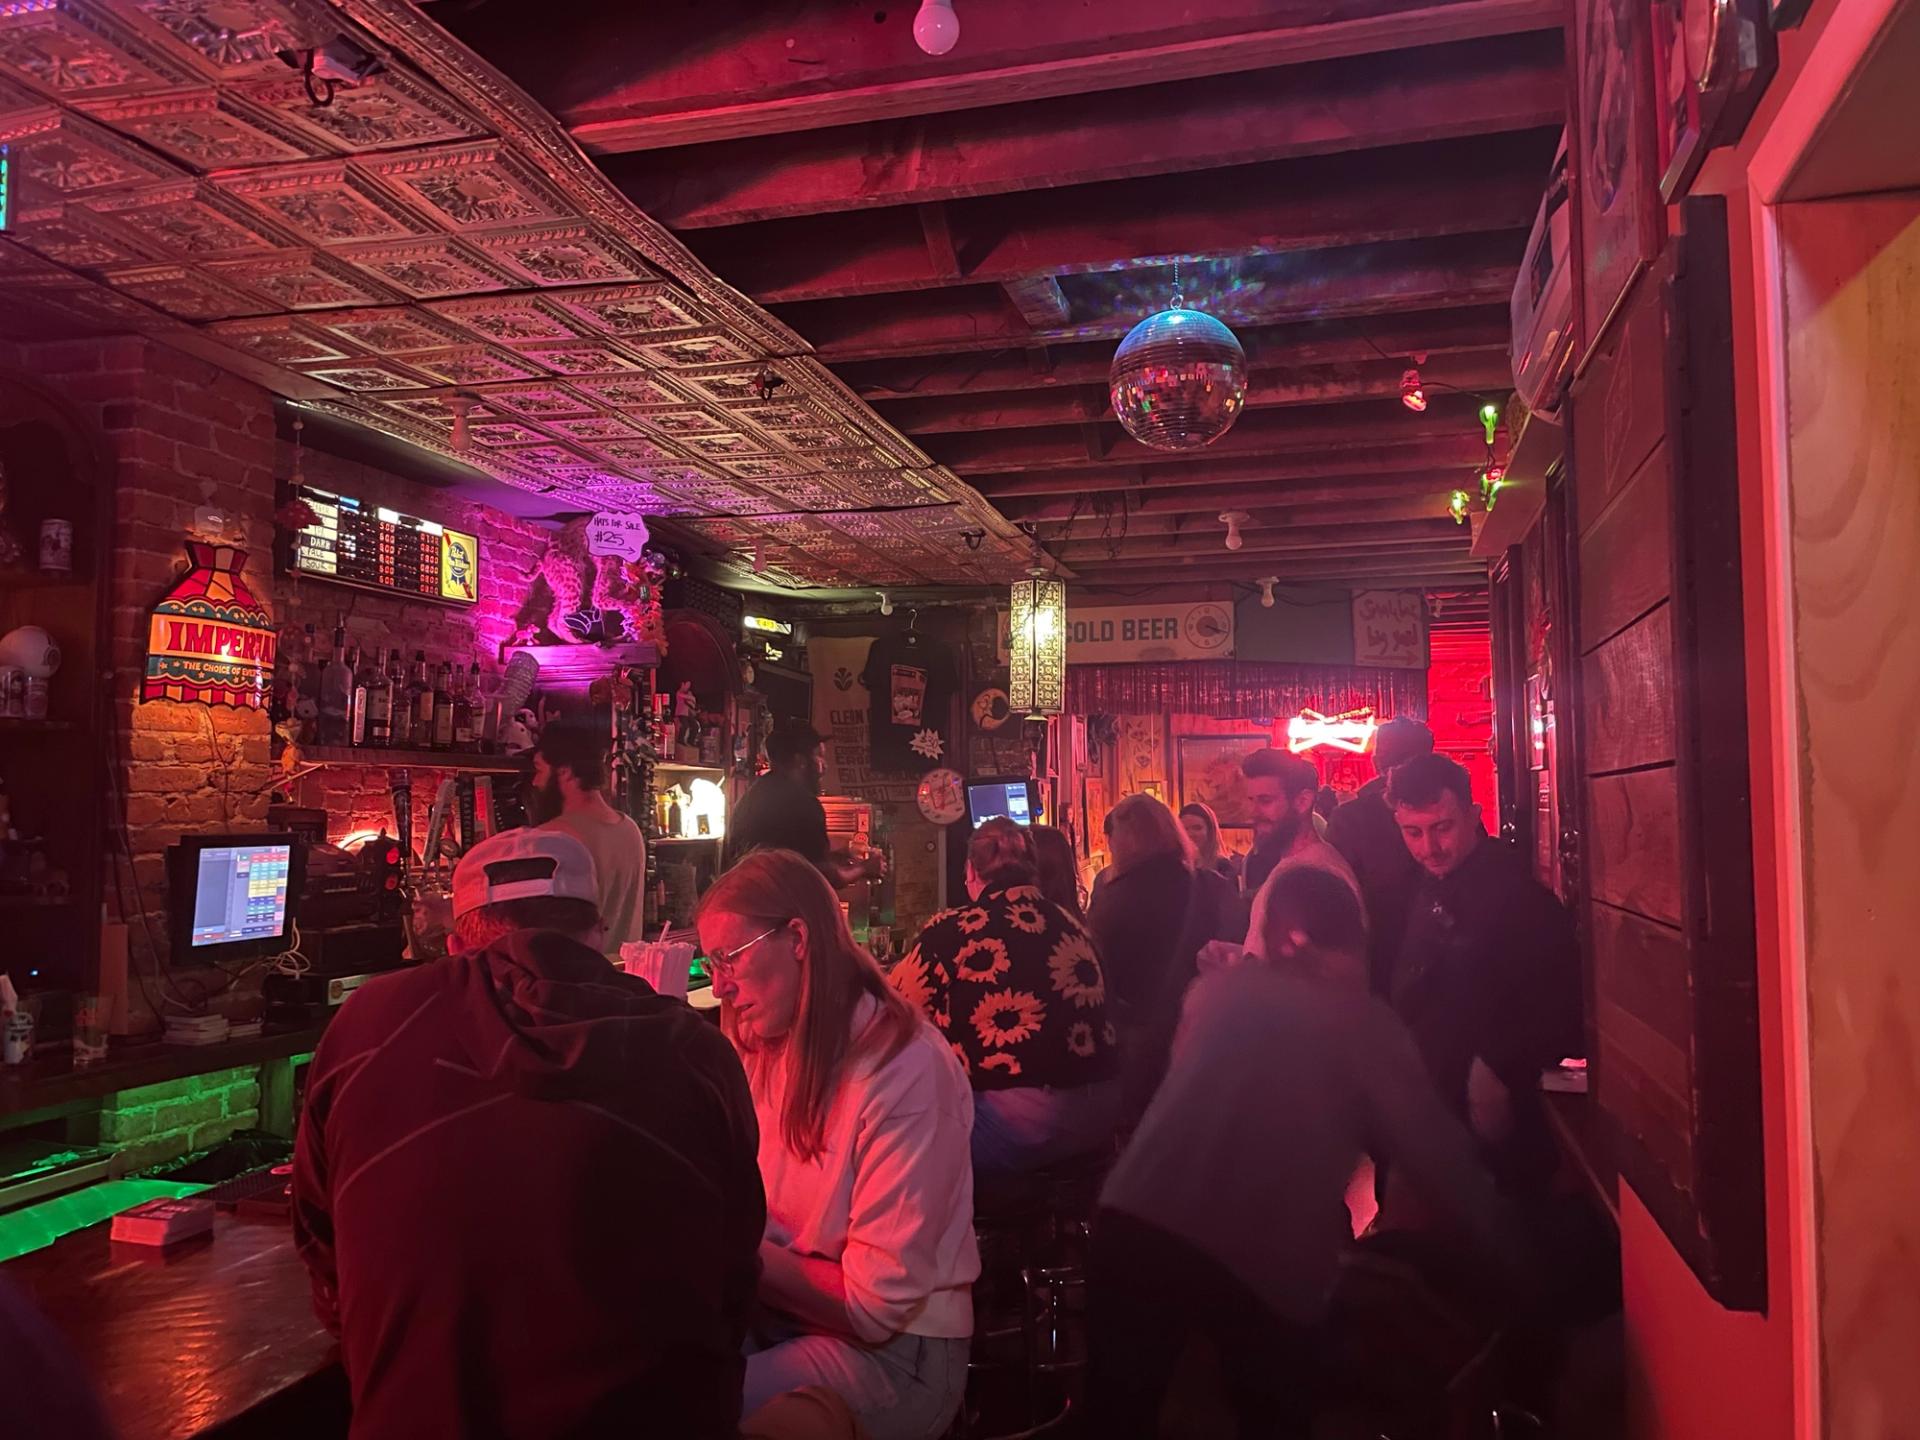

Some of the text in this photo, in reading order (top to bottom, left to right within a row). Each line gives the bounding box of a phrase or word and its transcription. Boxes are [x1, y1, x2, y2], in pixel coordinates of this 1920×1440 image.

[1122, 617, 1179, 642] BEER
[183, 661, 201, 672] THE
[203, 663, 230, 675] CHOICE
